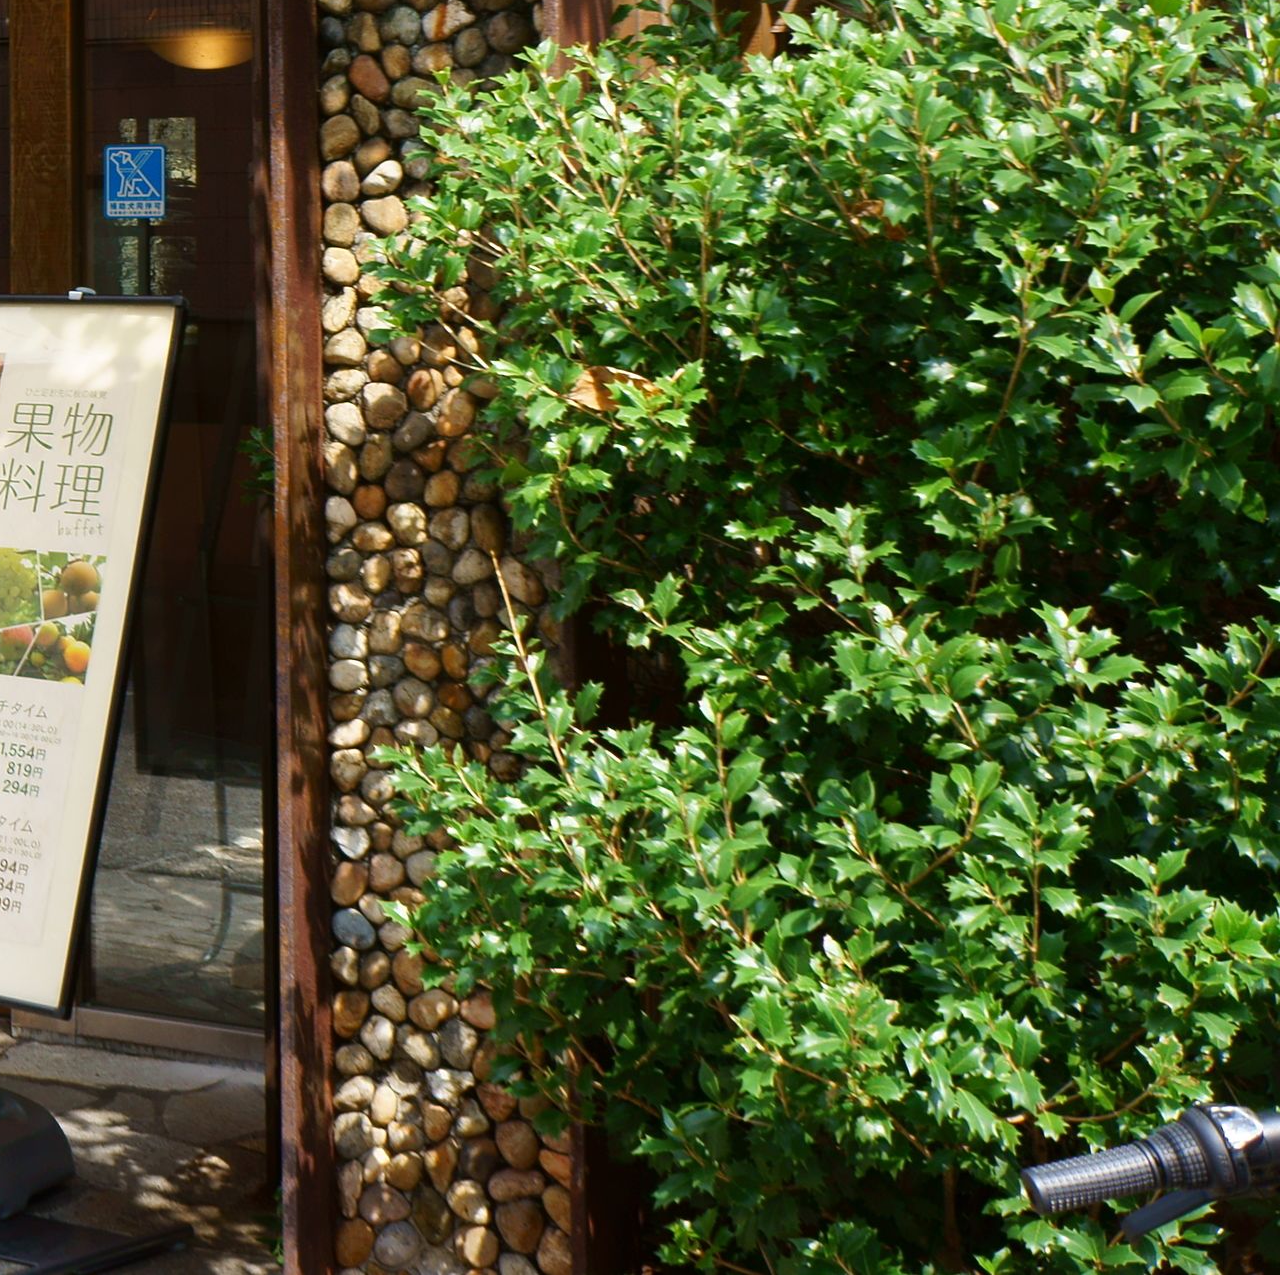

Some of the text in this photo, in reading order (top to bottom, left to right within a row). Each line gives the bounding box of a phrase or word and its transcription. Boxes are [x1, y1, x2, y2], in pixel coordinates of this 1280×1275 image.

[4, 402, 114, 457] 果物
[57, 518, 105, 537] buffet
[6, 761, 43, 779] 819円
[2, 779, 40, 798] 294円
